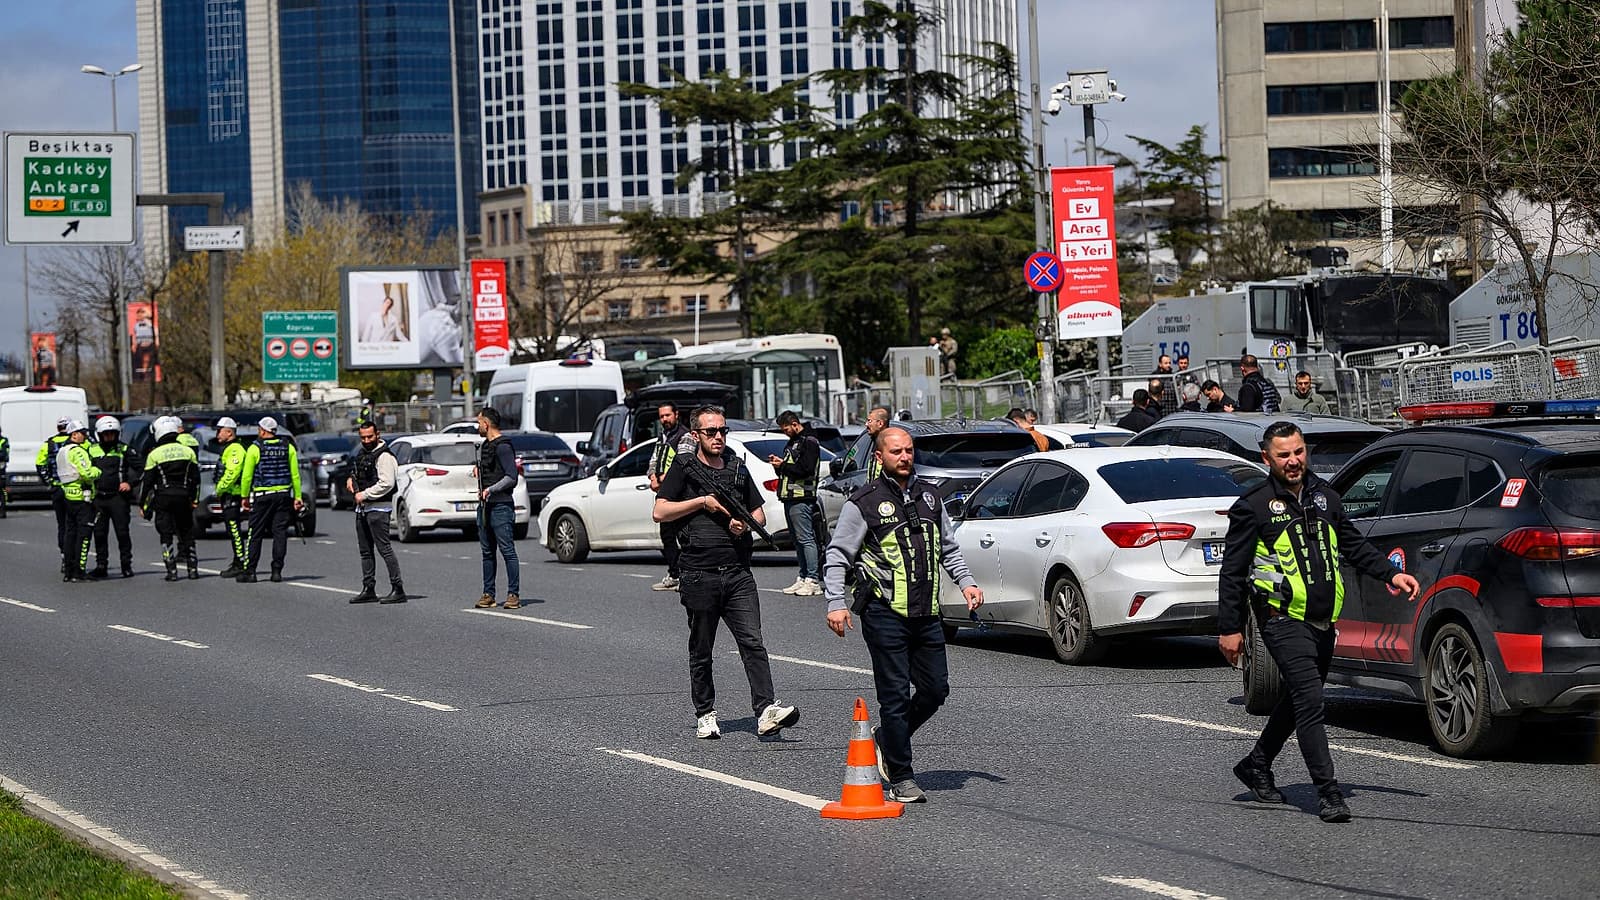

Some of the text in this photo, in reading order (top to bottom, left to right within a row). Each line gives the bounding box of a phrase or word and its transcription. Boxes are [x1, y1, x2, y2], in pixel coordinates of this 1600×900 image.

[29, 140, 113, 153] Beşiktaş
[28, 161, 107, 178] Kadıköy
[29, 180, 100, 194] Ankara
[1075, 203, 1092, 214] Ev
[1069, 223, 1102, 236] Araç
[1065, 243, 1107, 259] İş Yeri
[1500, 313, 1510, 340] T
[1453, 367, 1493, 383] POLİS
[1506, 481, 1522, 495] 112
